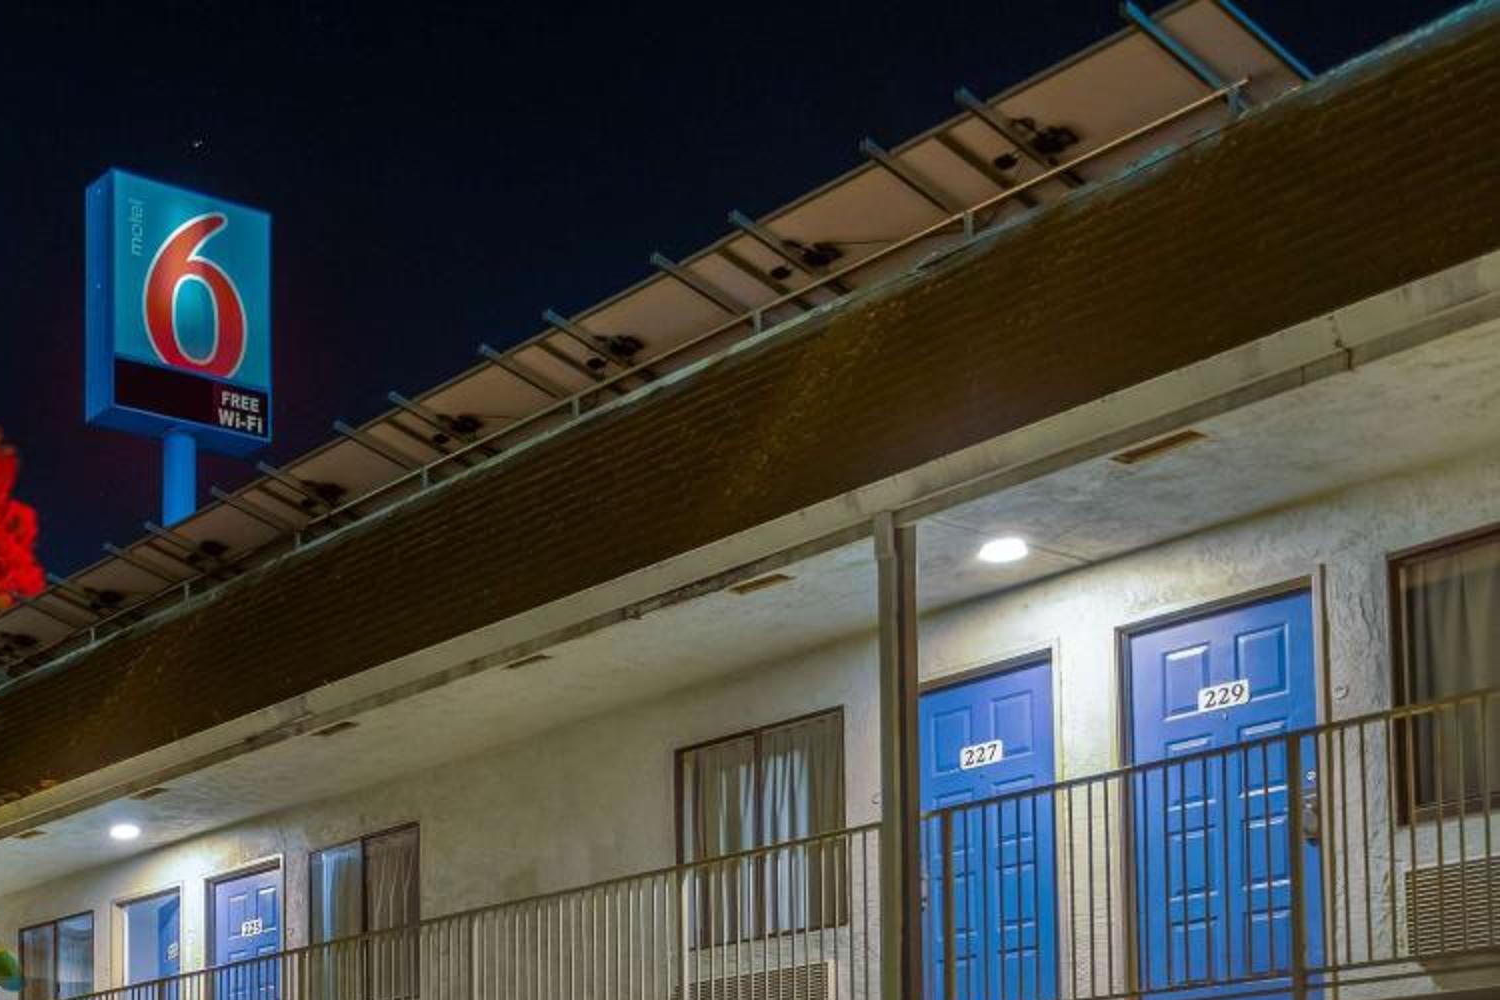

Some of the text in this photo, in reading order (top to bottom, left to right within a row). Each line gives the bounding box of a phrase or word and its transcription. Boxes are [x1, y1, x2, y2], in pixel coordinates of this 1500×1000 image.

[142, 212, 247, 379] 6
[221, 391, 260, 413] FREE
[218, 408, 263, 433] Wi-Fi
[1203, 684, 1245, 708] 229
[964, 743, 997, 767] 227
